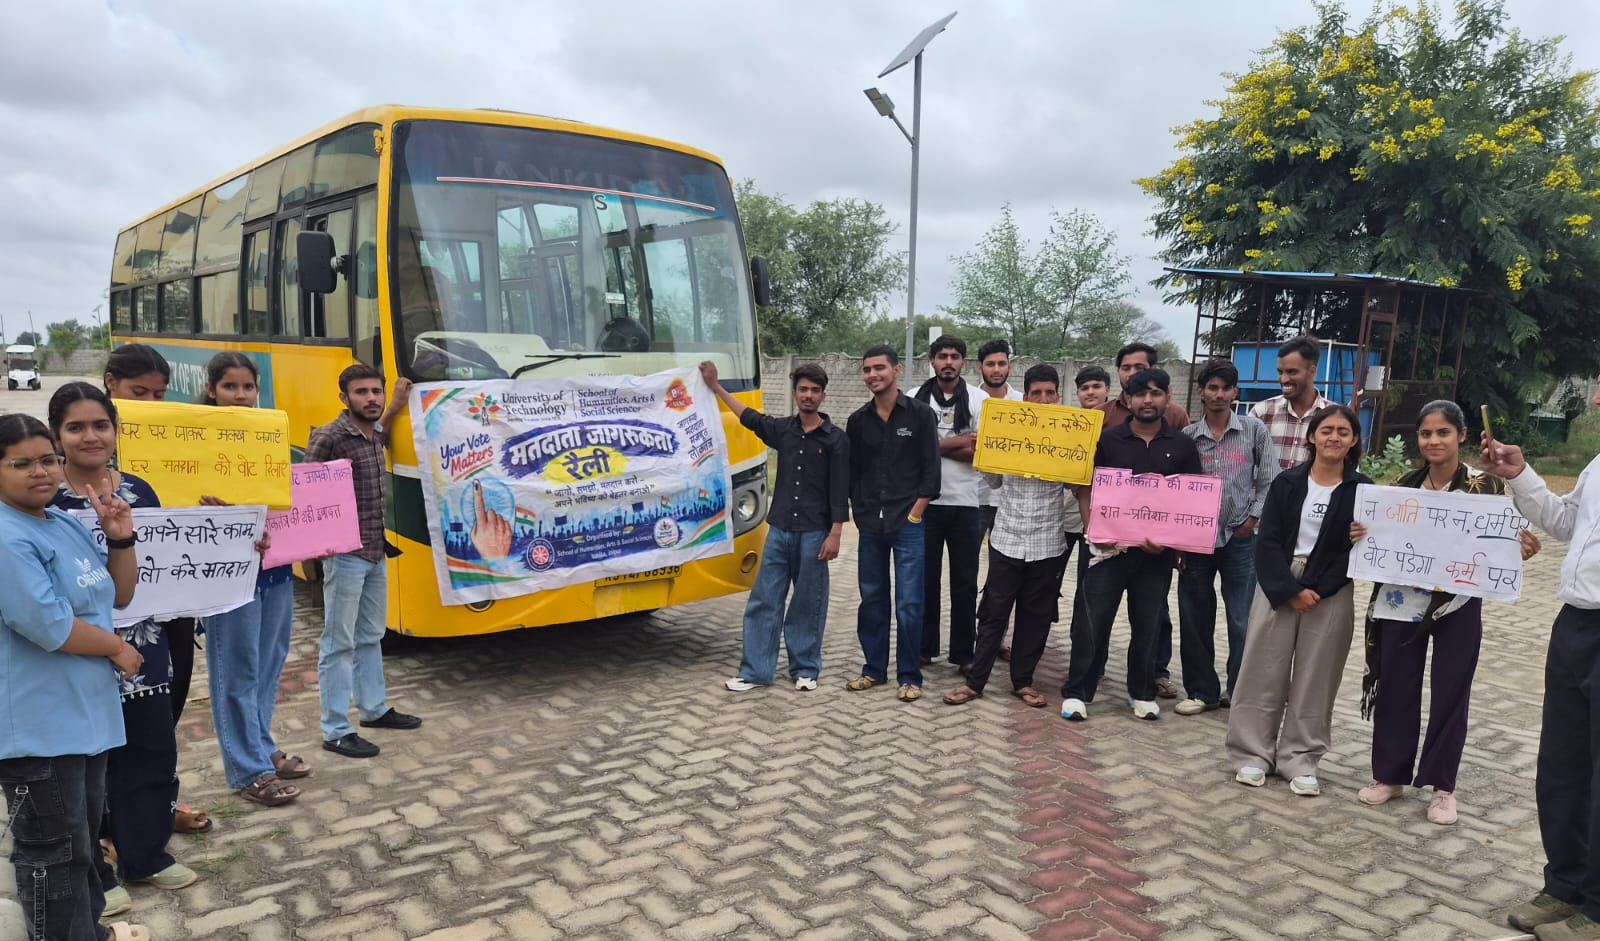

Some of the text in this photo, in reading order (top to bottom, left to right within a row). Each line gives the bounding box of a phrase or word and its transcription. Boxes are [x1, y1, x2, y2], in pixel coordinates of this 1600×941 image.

[501, 390, 564, 404] University of
[577, 388, 618, 398] School of
[579, 393, 655, 408] Humanities, Arts &
[502, 403, 567, 417] Technology
[580, 405, 642, 417] Social Sciences
[992, 411, 1004, 423] न
[1048, 418, 1059, 429] न
[148, 424, 168, 440] घर
[174, 426, 207, 441] जाकर
[440, 433, 490, 470] Your Vote
[509, 426, 582, 466] मतदाता
[984, 435, 1025, 453] मतदान
[1024, 437, 1036, 454] के
[1037, 436, 1059, 458] लिए
[128, 459, 151, 474] हर
[160, 459, 200, 475] मतदाता
[214, 453, 231, 477] को
[237, 454, 258, 477] वोट
[450, 445, 494, 477] Matters
[561, 448, 611, 481] रैली
[600, 480, 623, 489] मतदान
[625, 475, 638, 485] करो
[1095, 472, 1112, 487] क्या
[1115, 471, 1125, 487] है
[1187, 481, 1214, 493] शान
[554, 497, 573, 508] अपने
[575, 494, 596, 505] भविष्य
[598, 491, 608, 501] को
[609, 490, 627, 500] बेहतर
[291, 507, 300, 526] की
[1099, 505, 1120, 519] शत
[1173, 513, 1215, 528] मतदान
[1365, 501, 1379, 520] न
[1386, 498, 1424, 525] जाति
[1426, 507, 1452, 529] पर
[1474, 508, 1512, 537] धर्म
[135, 518, 184, 543] अपने
[184, 518, 224, 545] सारे
[201, 560, 252, 580] मतदान
[1363, 537, 1519, 590] वोट पड़ेगा कर्म पर
